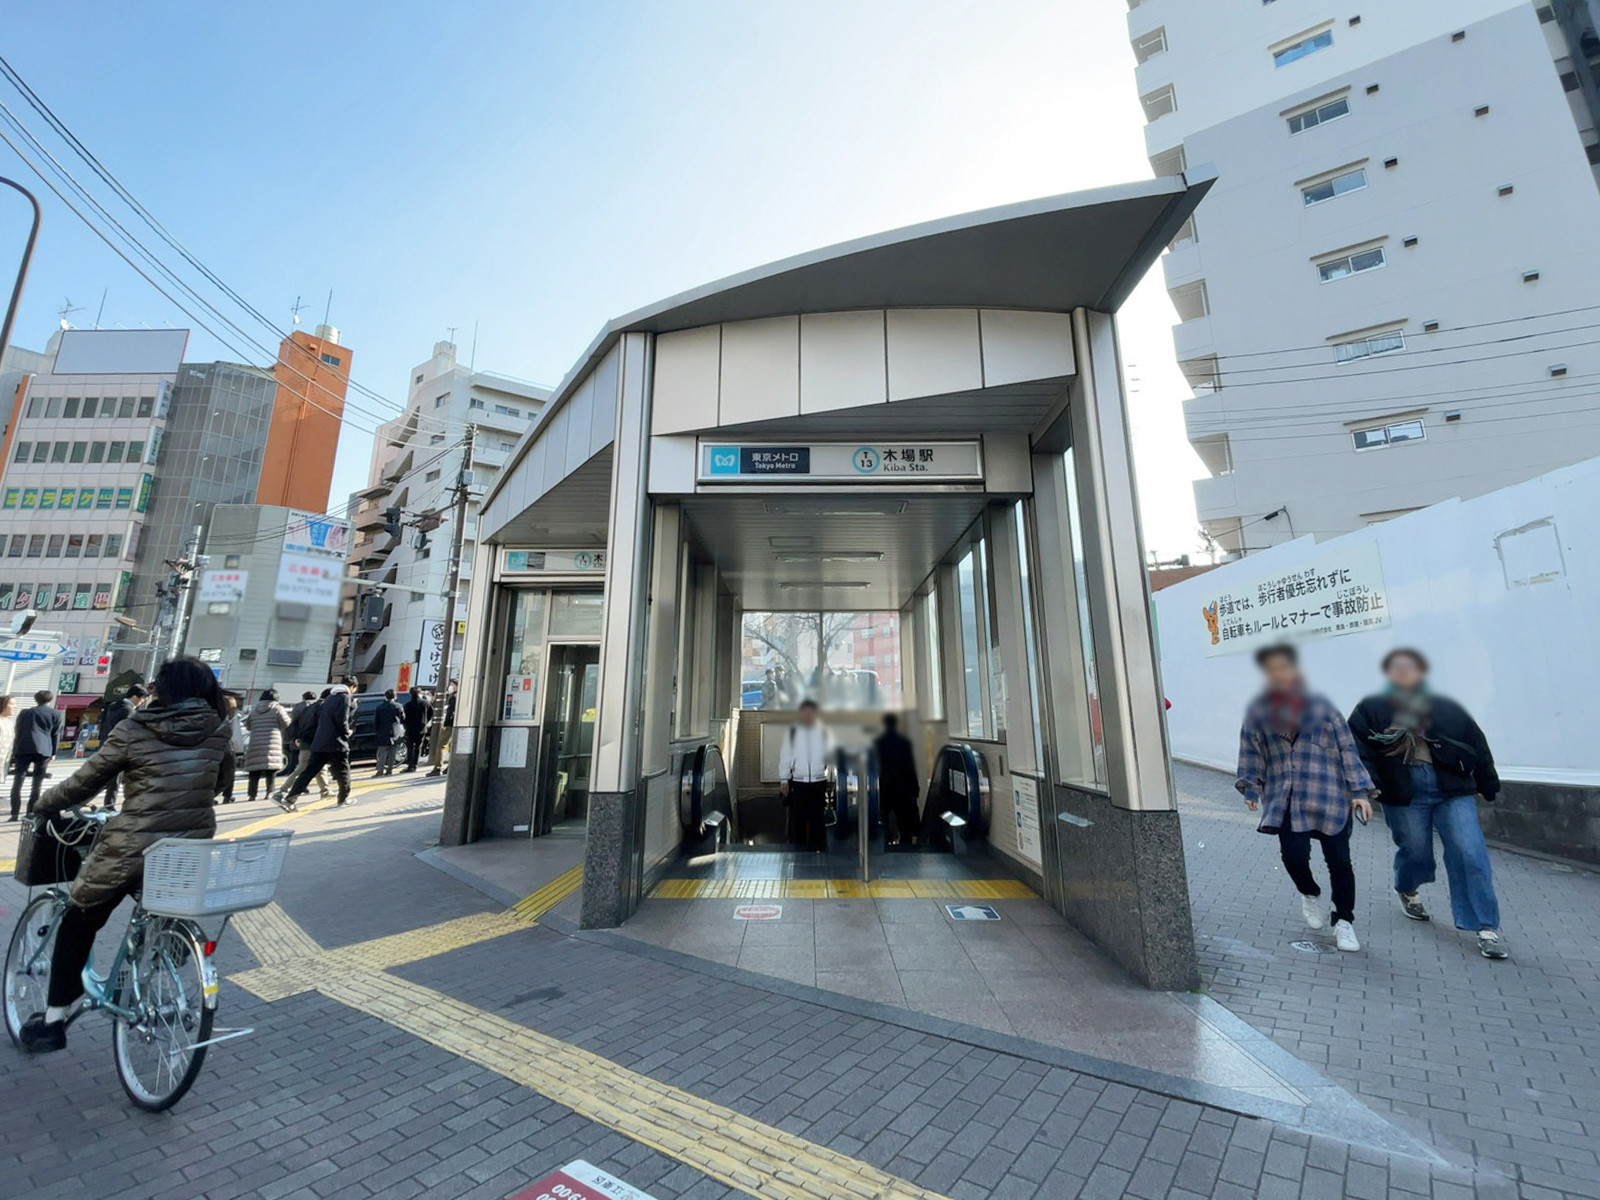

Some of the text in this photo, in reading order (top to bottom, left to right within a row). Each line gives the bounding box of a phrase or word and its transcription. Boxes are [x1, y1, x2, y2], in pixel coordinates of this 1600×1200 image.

[752, 453, 799, 461] 東京メトロ
[883, 449, 934, 463] 木場駅
[755, 462, 775, 470] Tokyo
[861, 459, 873, 468] 13
[883, 463, 928, 472] Kiba Sta.
[23, 492, 94, 506] カラオケ
[1222, 592, 1384, 640] 自転車もルールとマナーで事故防止
[429, 641, 443, 684] てけてけ
